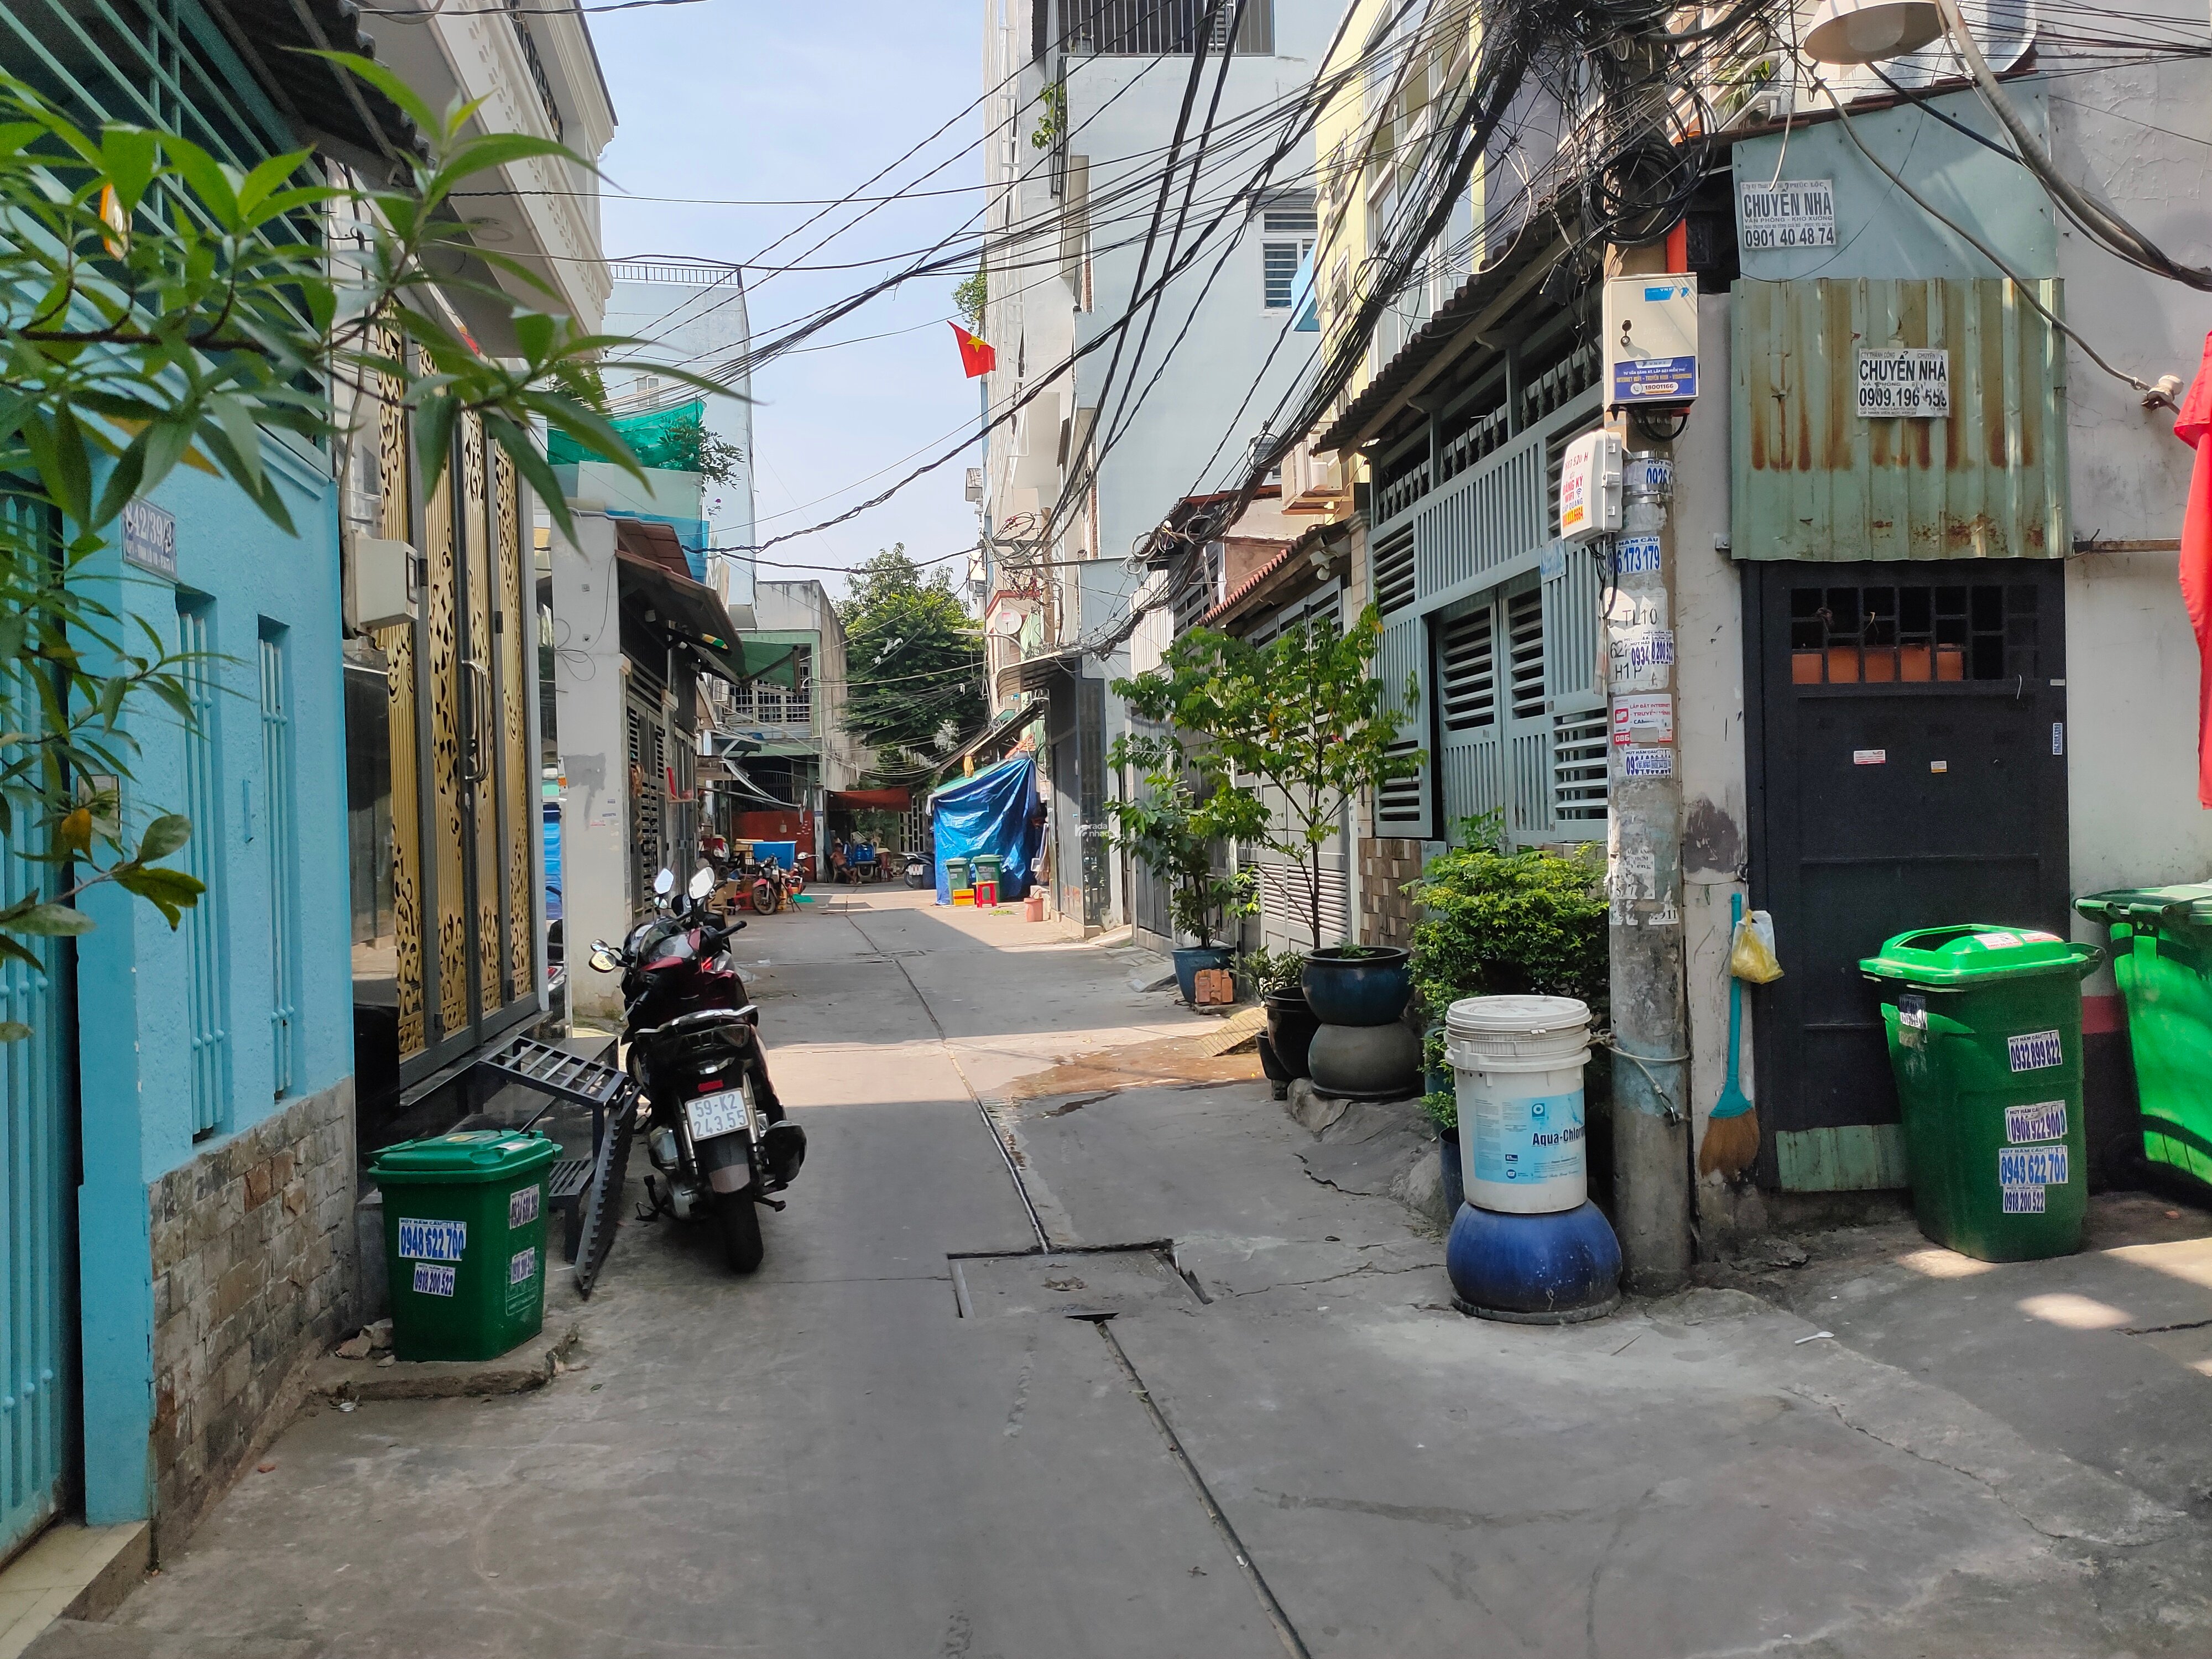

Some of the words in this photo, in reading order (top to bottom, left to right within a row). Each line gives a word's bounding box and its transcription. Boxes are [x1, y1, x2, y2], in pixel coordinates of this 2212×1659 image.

[1804, 186, 1832, 216] NHÀ
[1746, 229, 1775, 247] 0901
[1780, 228, 1795, 246] 40
[1799, 227, 1814, 244] 48
[1818, 227, 1834, 244] 74
[1859, 351, 1915, 381] CHUYỂN
[1919, 355, 1947, 382] NHÀ
[2011, 1039, 2061, 1070] 0932.899.822
[695, 1093, 737, 1118] 59-K2
[694, 1109, 746, 1137] 243.55
[2001, 1154, 2066, 1184] 0948.622.700
[2005, 1192, 2044, 1212] 0918.200.522
[401, 1225, 464, 1259] 0948.622.700
[415, 1269, 453, 1296] 0918.200.522
